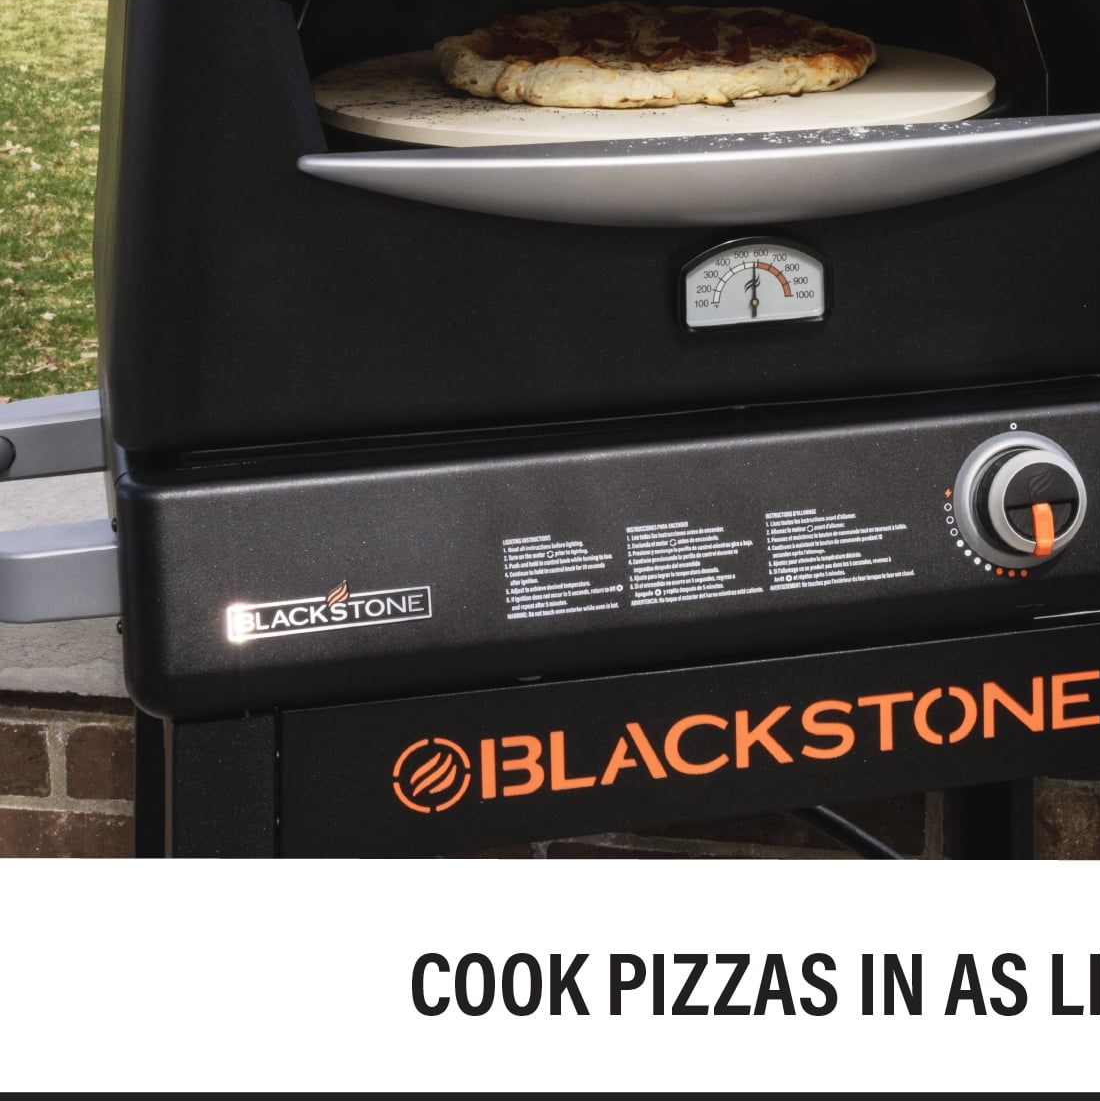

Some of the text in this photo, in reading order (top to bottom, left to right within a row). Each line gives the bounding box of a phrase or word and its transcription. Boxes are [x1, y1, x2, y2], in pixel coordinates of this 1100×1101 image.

[753, 249, 768, 257] 600
[715, 258, 730, 266] 400
[784, 264, 800, 272] 800
[793, 277, 808, 285] 900
[796, 290, 814, 298] 1000
[695, 300, 709, 308] 100
[234, 594, 424, 633] BLACKSTONE
